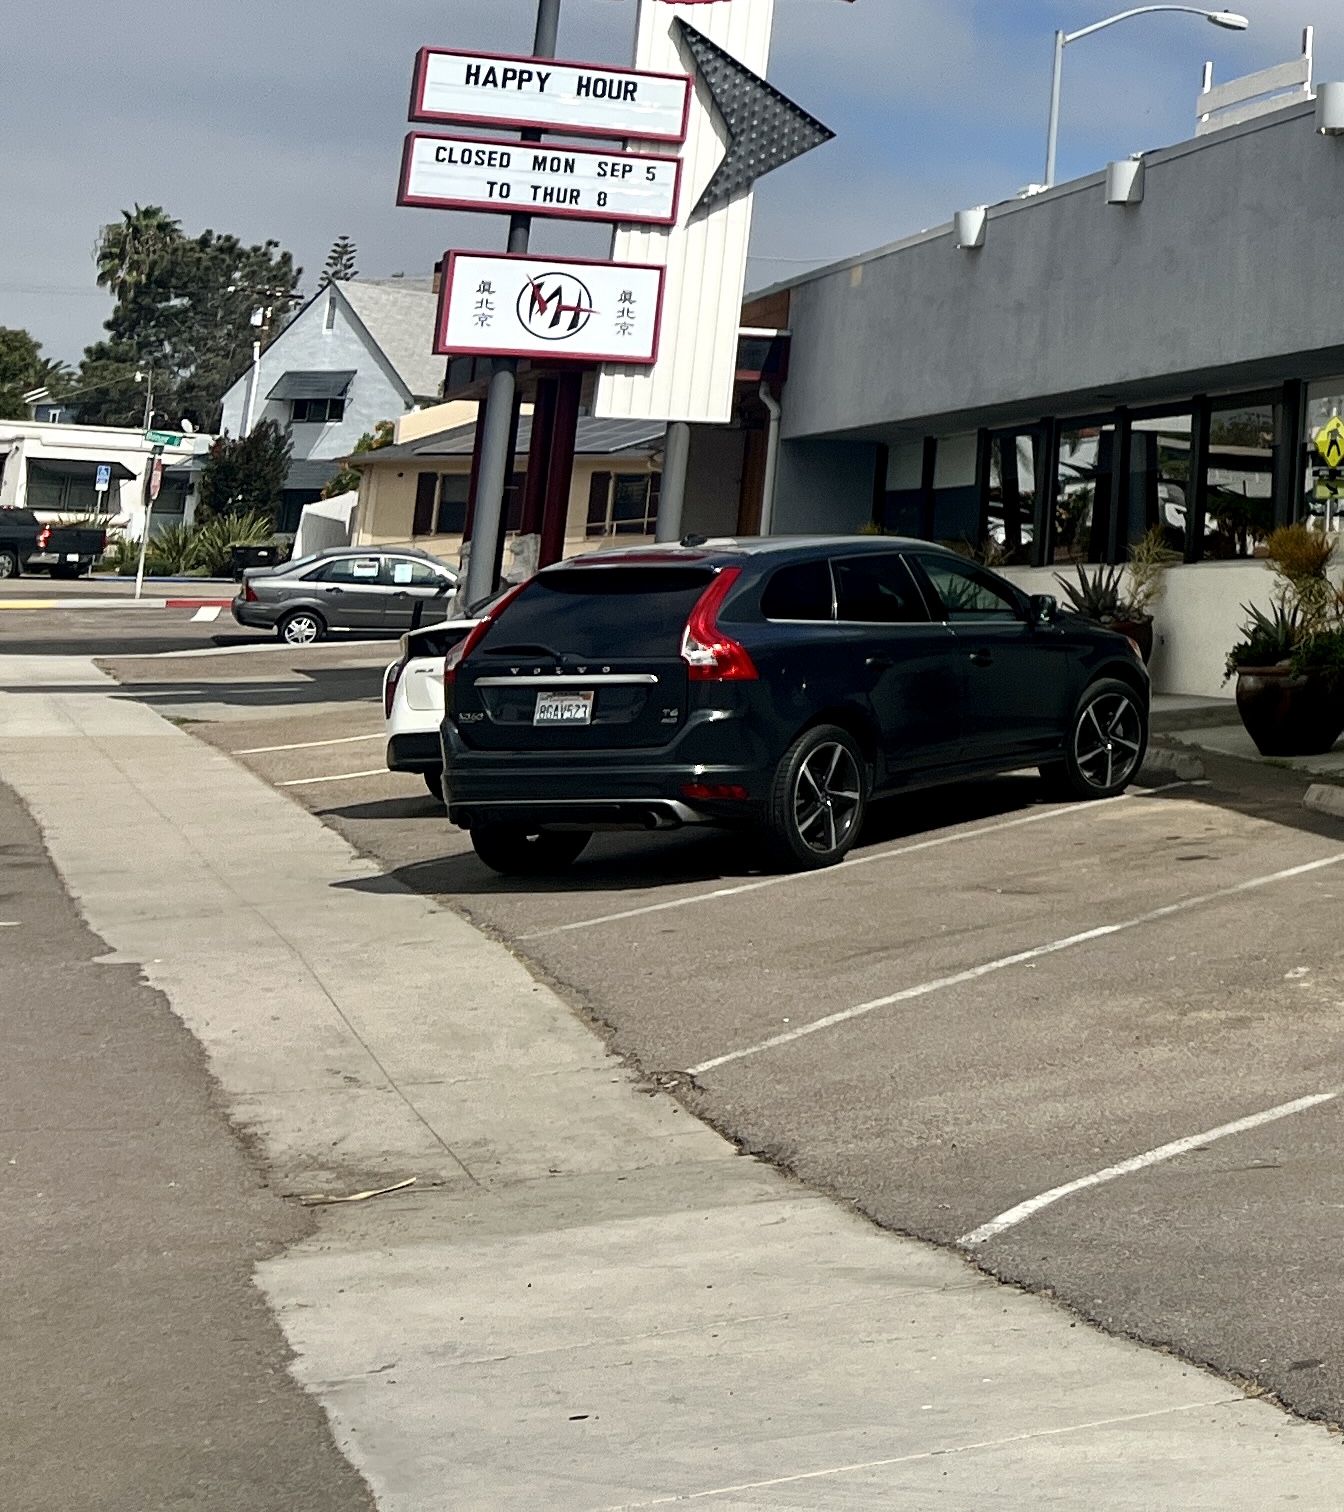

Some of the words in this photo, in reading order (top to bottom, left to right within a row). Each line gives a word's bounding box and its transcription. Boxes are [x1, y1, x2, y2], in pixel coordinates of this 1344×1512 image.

[465, 63, 552, 93] HAPPY
[576, 75, 638, 102] HOUR
[434, 146, 511, 169] CLOSED
[531, 154, 576, 174] MON
[596, 161, 634, 179] SEP
[645, 166, 657, 182] 5
[486, 180, 511, 199] TO
[530, 184, 581, 206] THUR
[596, 191, 608, 207] 8
[510, 665, 611, 676] VOLVO
